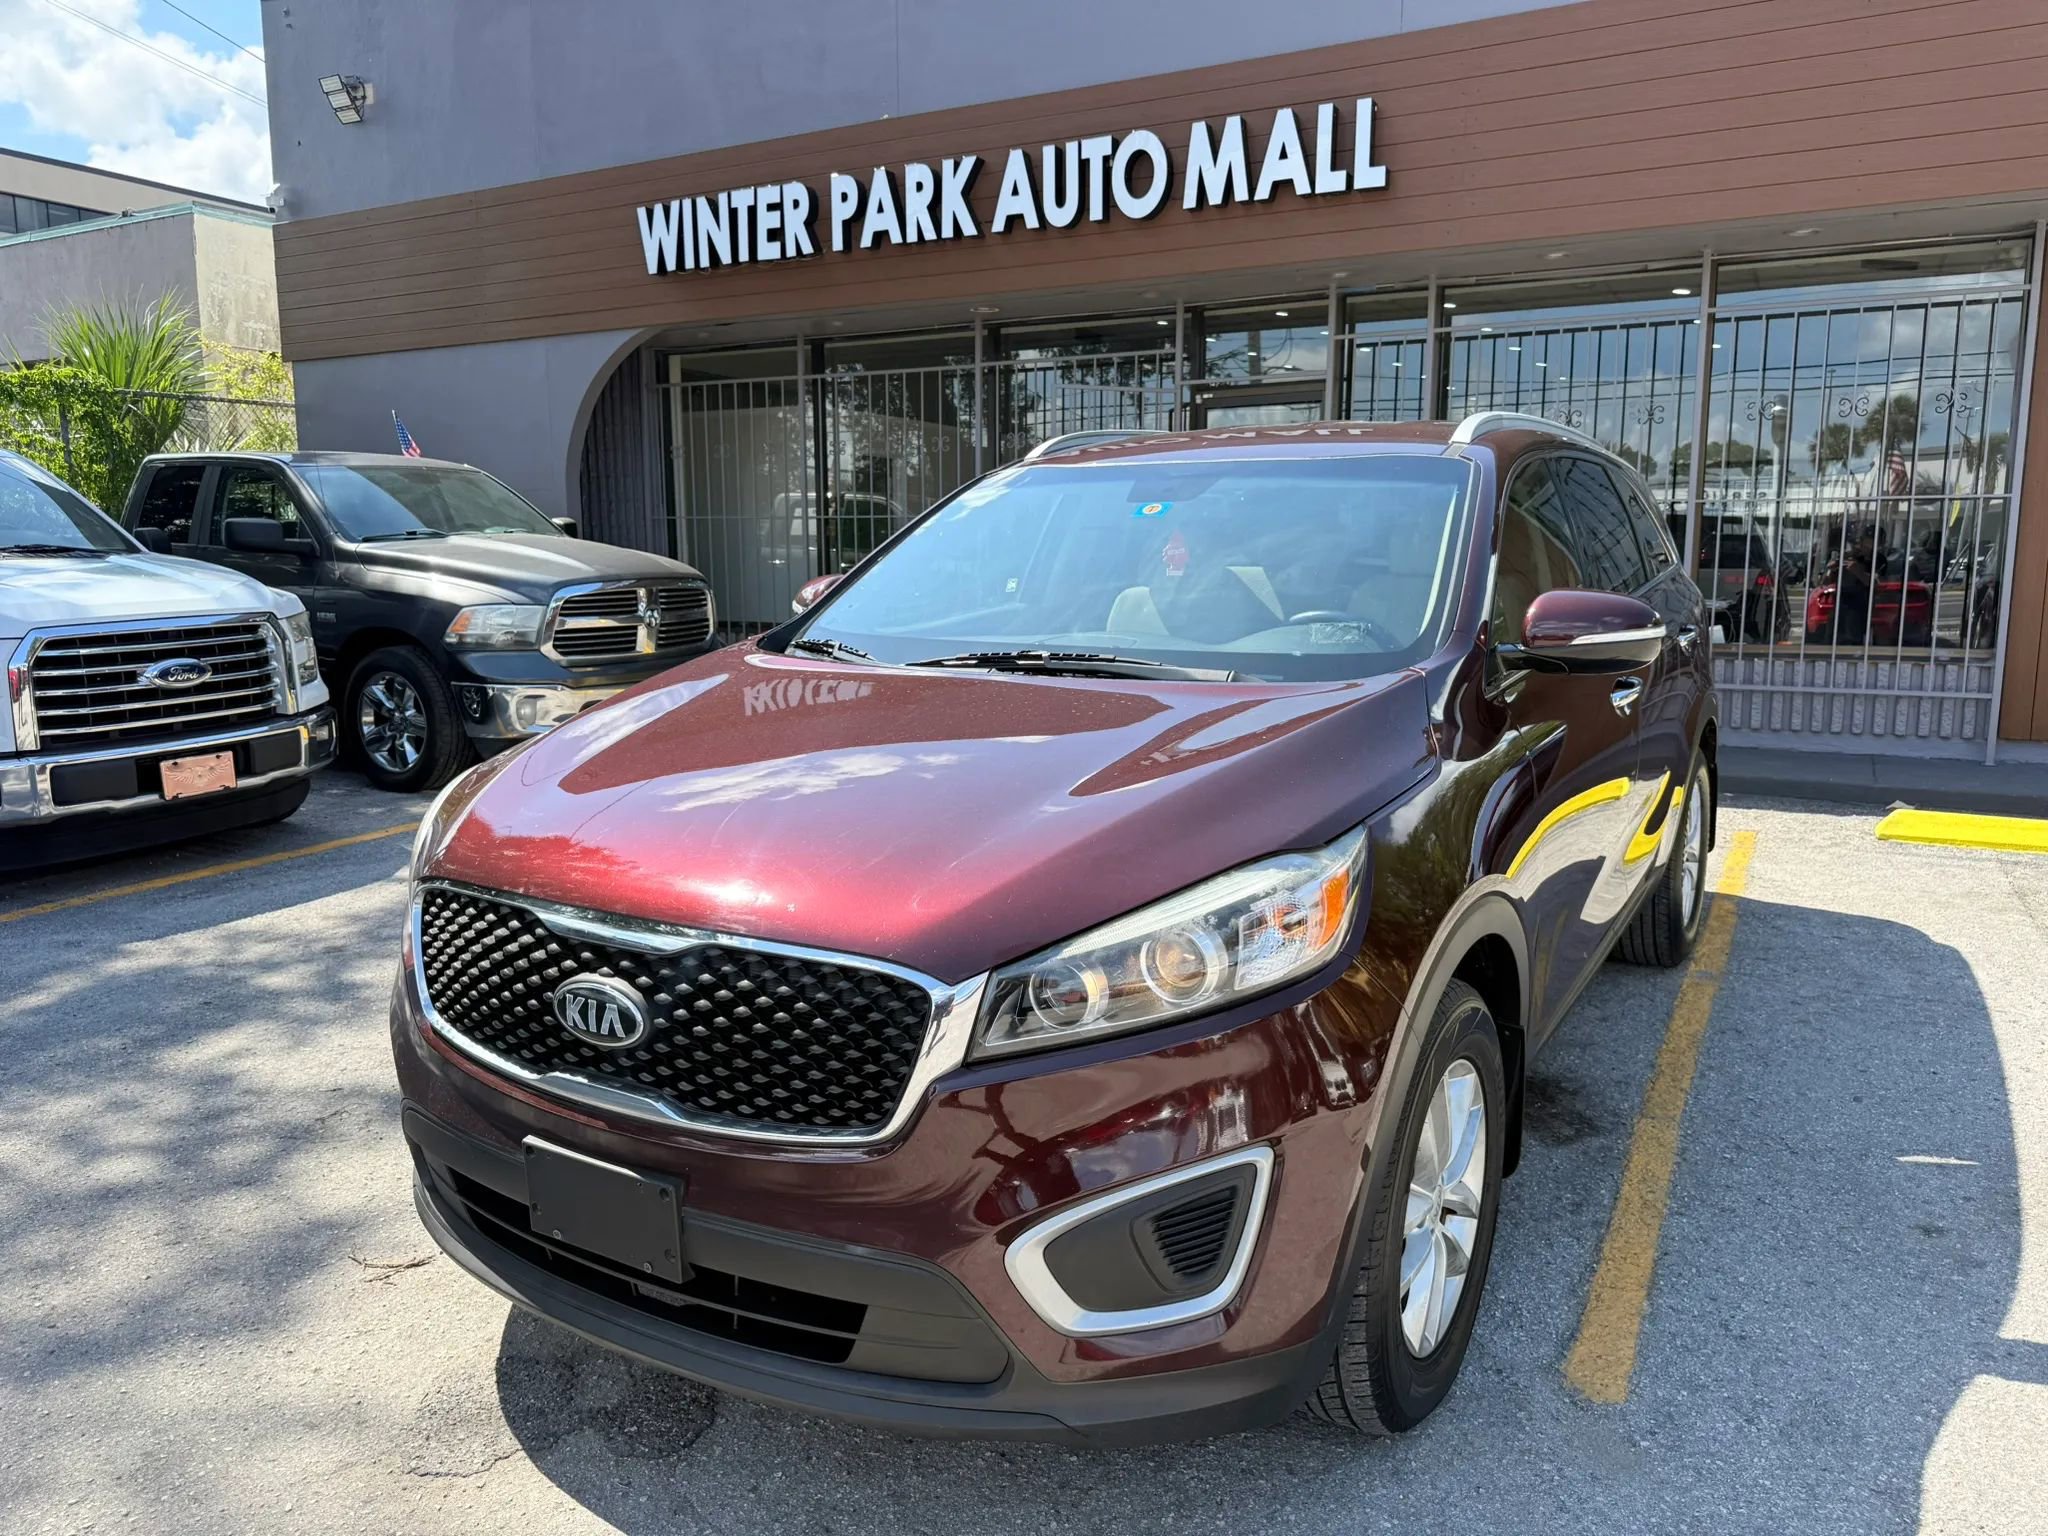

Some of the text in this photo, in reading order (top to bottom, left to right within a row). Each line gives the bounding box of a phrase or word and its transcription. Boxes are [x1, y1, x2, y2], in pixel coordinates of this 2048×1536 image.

[637, 97, 1387, 275] WINTER PARK AUTO MALL
[167, 666, 199, 681] Ford
[565, 993, 626, 1038] KIA
